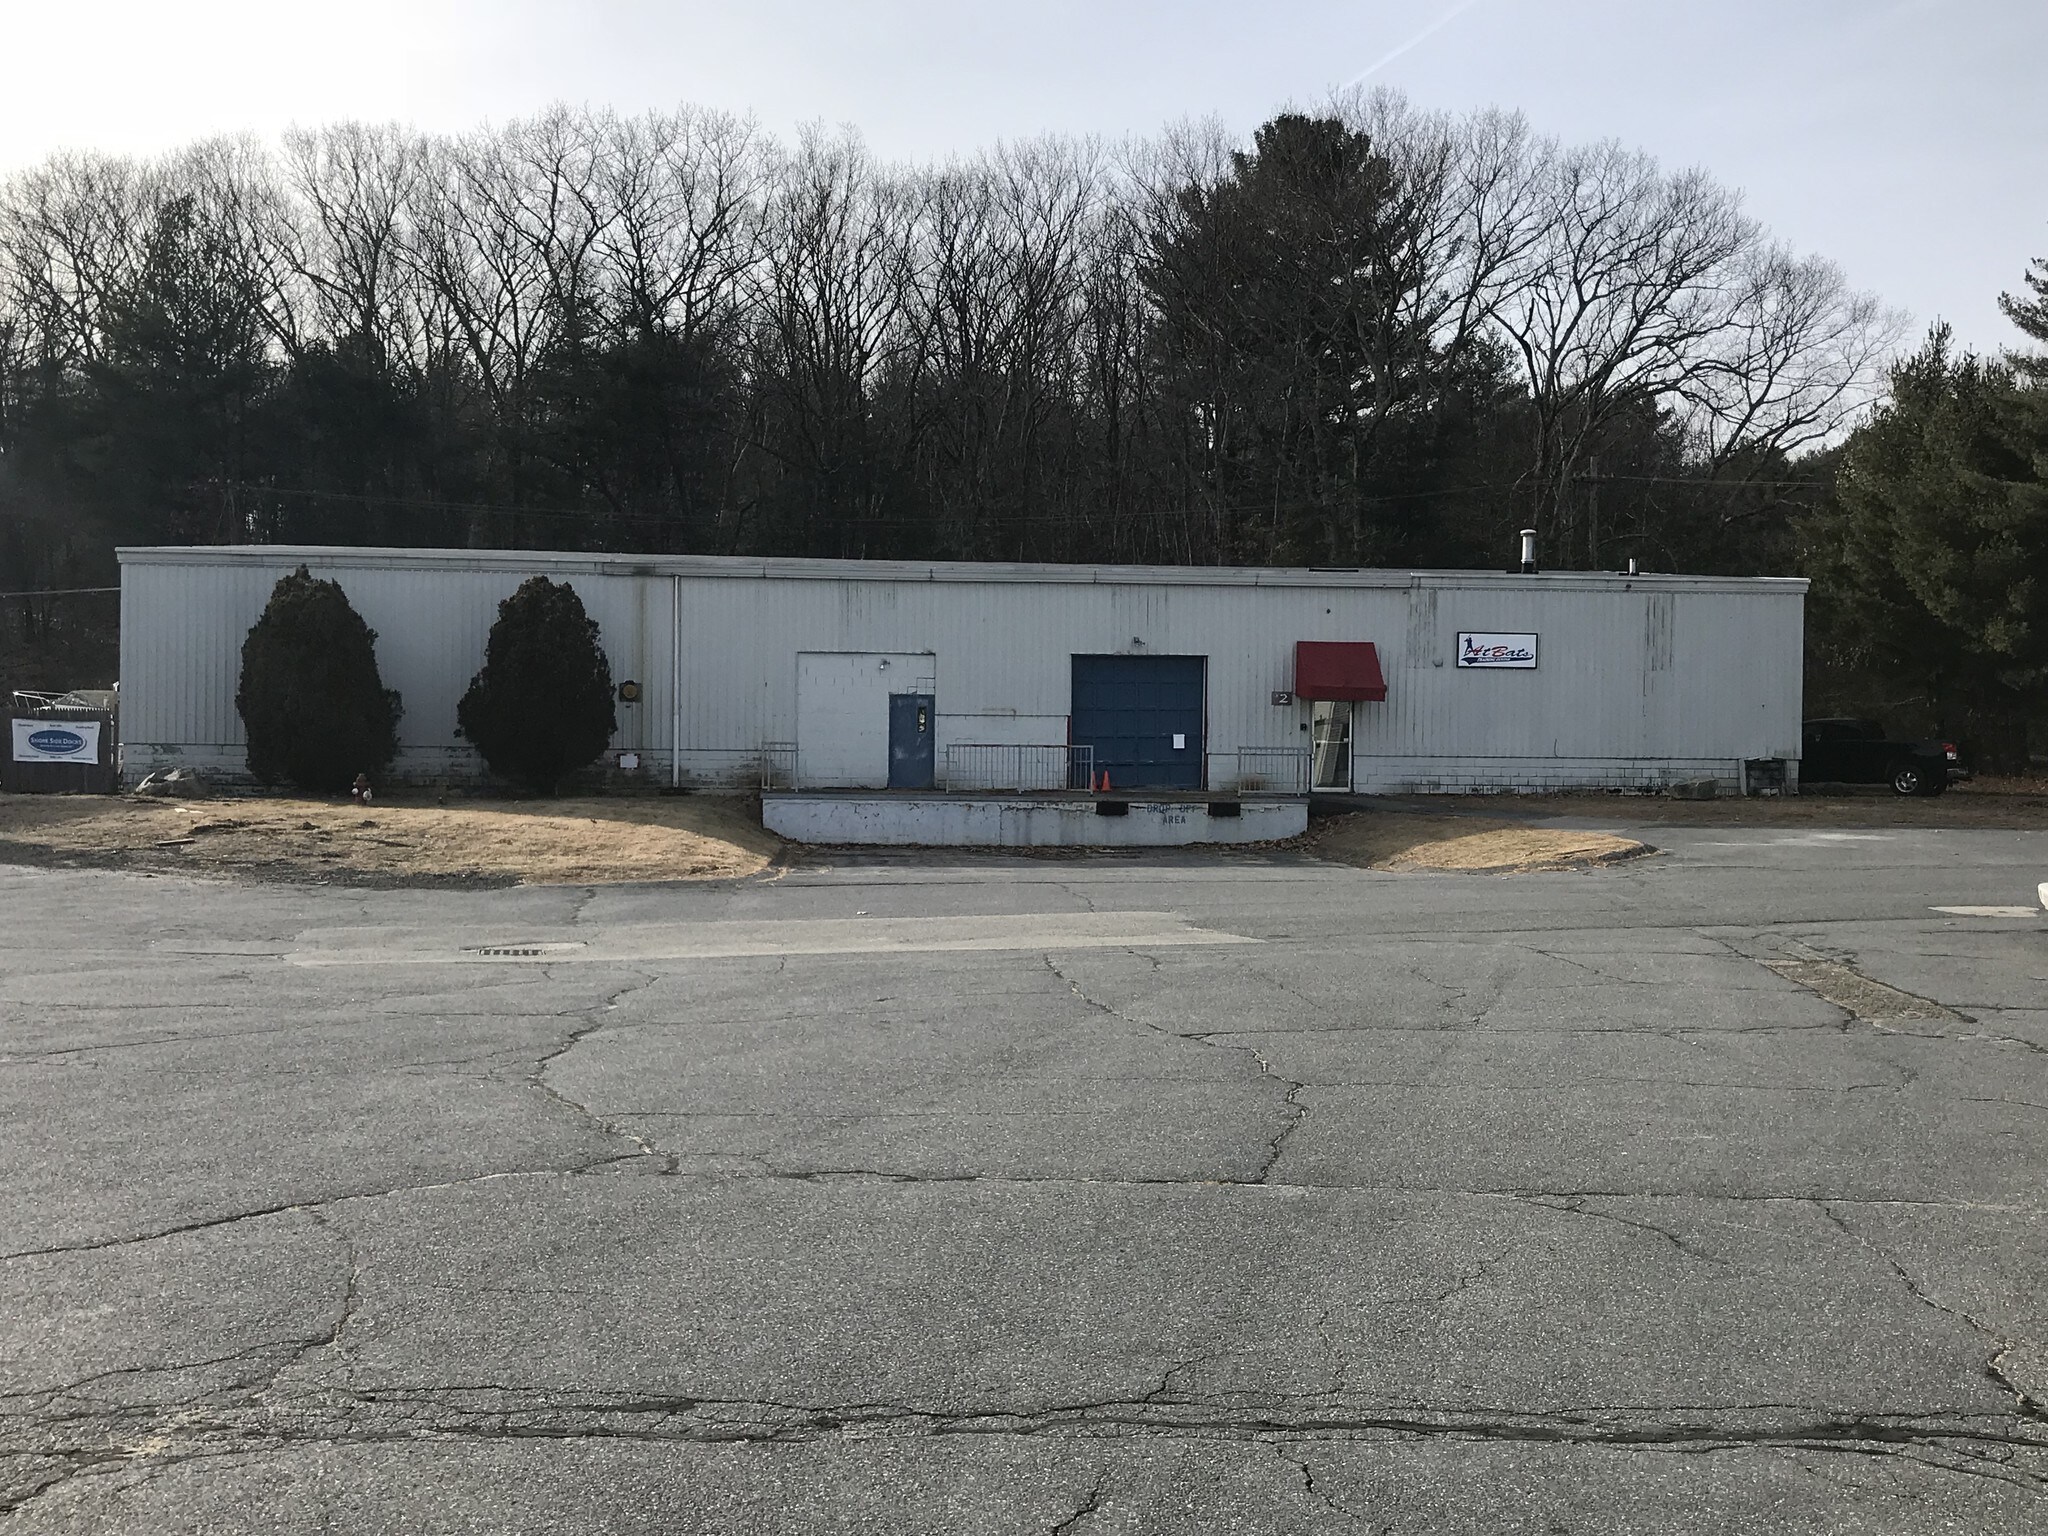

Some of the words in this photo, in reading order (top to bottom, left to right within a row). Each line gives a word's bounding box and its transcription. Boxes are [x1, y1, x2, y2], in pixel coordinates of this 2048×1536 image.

[1491, 646, 1529, 657] Bats
[1279, 693, 1288, 703] 2
[1146, 804, 1171, 813] DROP
[1162, 815, 1186, 824] AREA
